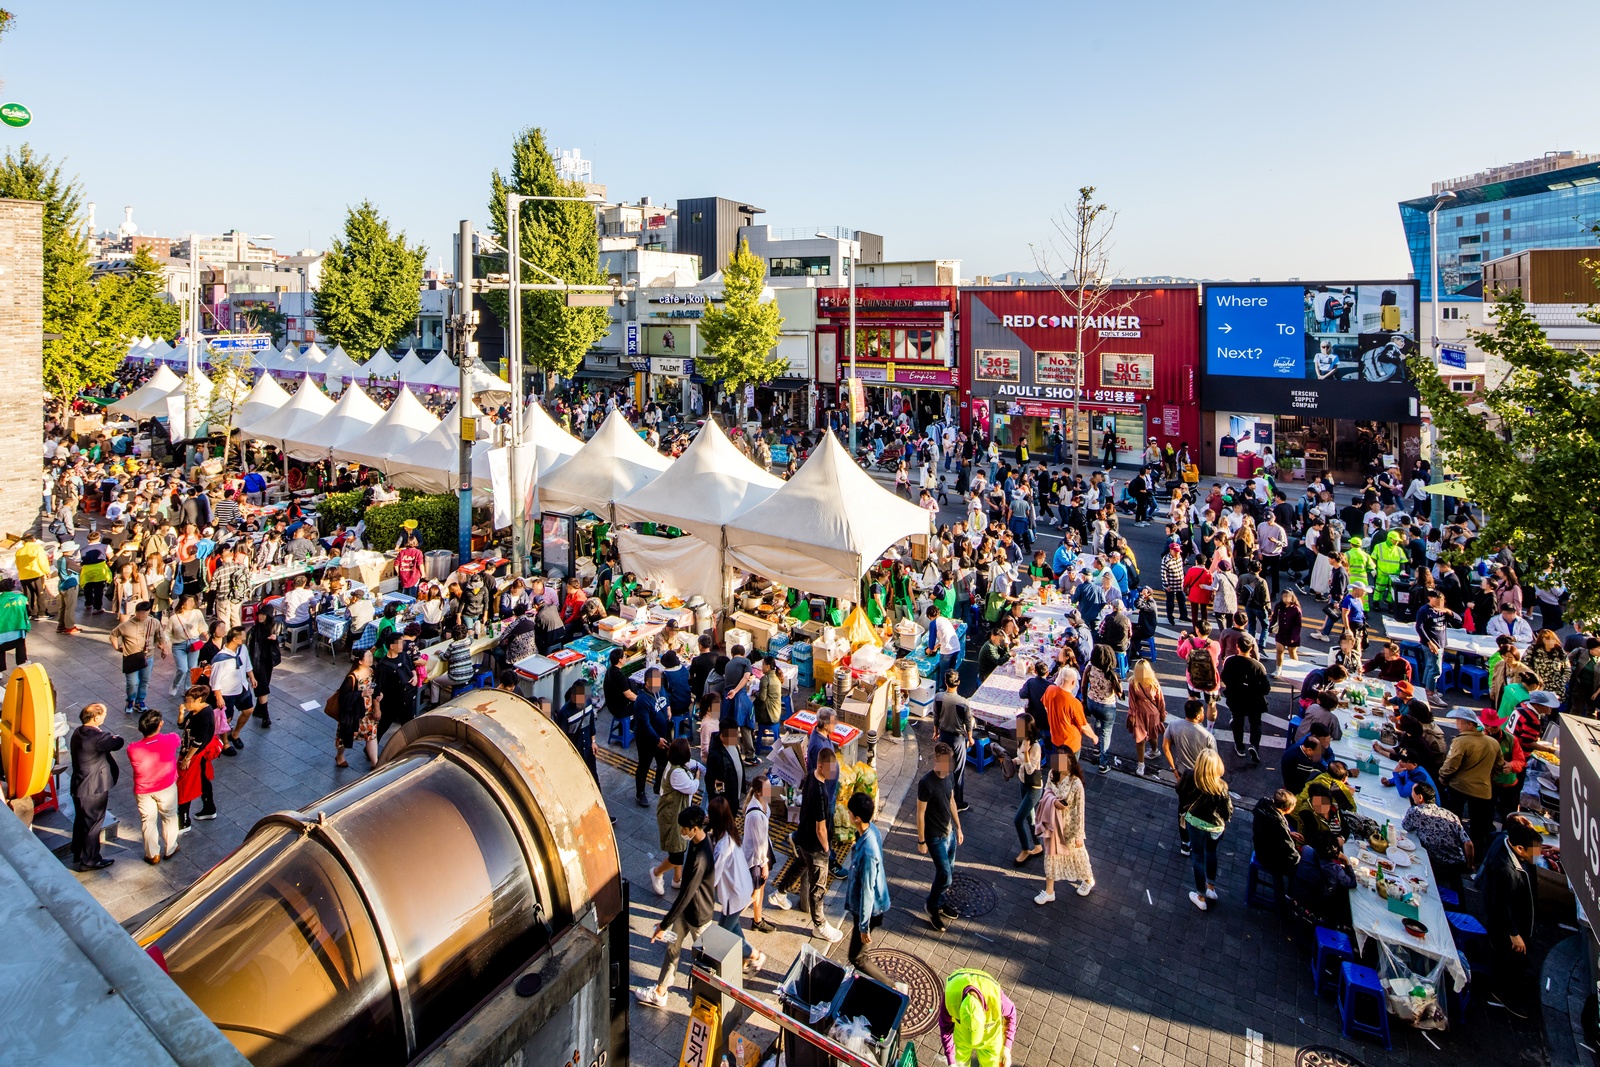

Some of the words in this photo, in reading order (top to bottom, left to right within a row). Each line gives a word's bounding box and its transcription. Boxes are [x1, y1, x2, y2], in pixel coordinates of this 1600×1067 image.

[659, 295, 680, 304] cafe
[863, 299, 893, 307] CHINESE
[1216, 295, 1268, 307] Where
[1003, 315, 1035, 328] RED
[1276, 323, 1296, 335] To
[1217, 347, 1263, 359] Next?
[987, 357, 1010, 367] 365
[1049, 357, 1073, 366] No.1
[659, 364, 680, 372] TALENT
[987, 367, 1010, 377] SALE
[1116, 363, 1139, 373] BIG
[909, 371, 937, 382] Empire
[1114, 373, 1141, 382] SALE
[998, 384, 1043, 397] ADULT
[1093, 390, 1136, 403] 성인용품
[1119, 444, 1133, 452] ALE
